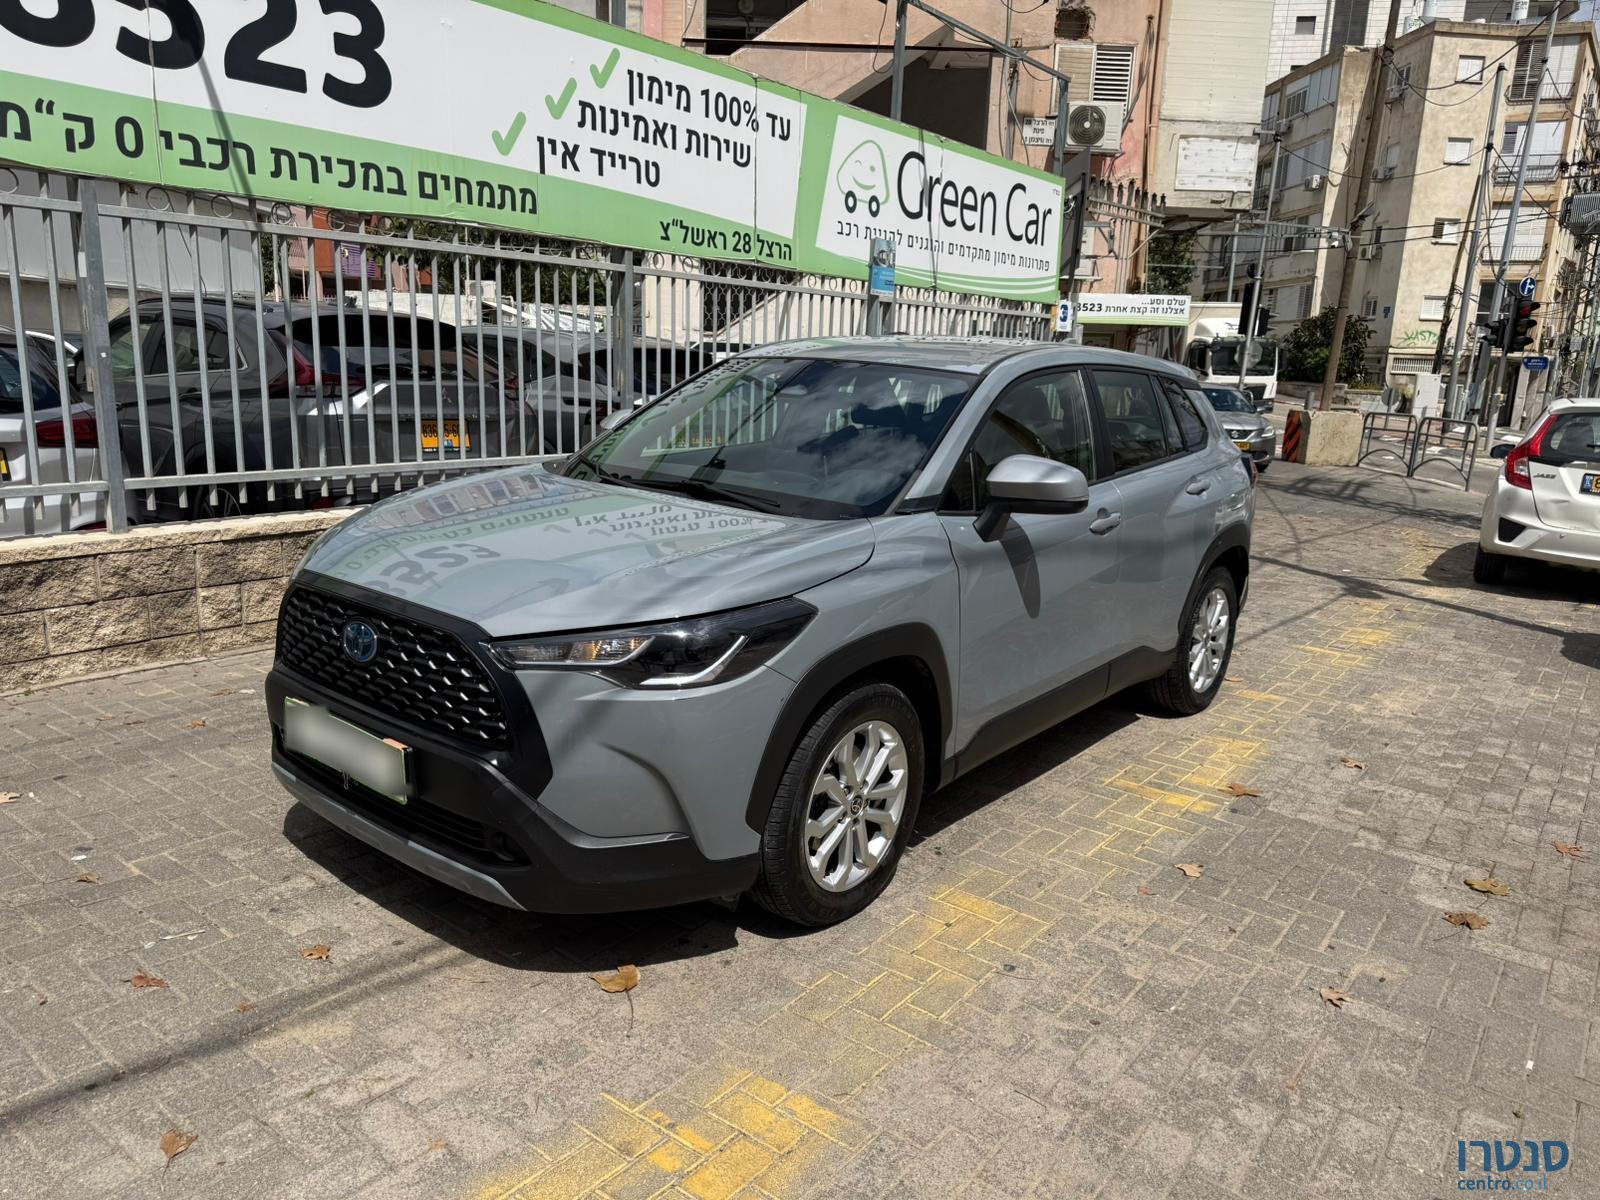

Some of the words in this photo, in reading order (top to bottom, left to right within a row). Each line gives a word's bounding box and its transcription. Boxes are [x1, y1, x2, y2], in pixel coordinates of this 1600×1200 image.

[627, 69, 692, 113] מימון
[578, 100, 677, 151] ואמינות
[701, 89, 760, 133] 100%
[767, 112, 791, 141] עד
[115, 116, 144, 158] 0
[159, 130, 256, 175] רכבי
[536, 136, 580, 175] אין
[685, 129, 751, 168] שירות
[271, 147, 407, 196] במכירת
[590, 147, 660, 188] טרייד
[418, 171, 537, 215] מתמחים
[897, 151, 997, 236] Green
[1005, 182, 1052, 247] Car
[732, 231, 752, 254] 28
[756, 234, 792, 261] הרצל
[837, 220, 859, 238] רכב
[948, 242, 991, 262] מתקדמים
[993, 250, 1016, 267] מימון
[1019, 255, 1050, 272] פתרונות
[1130, 306, 1148, 315] קצת
[1161, 306, 1185, 315] אצלנו
[1167, 297, 1187, 306] שלם
